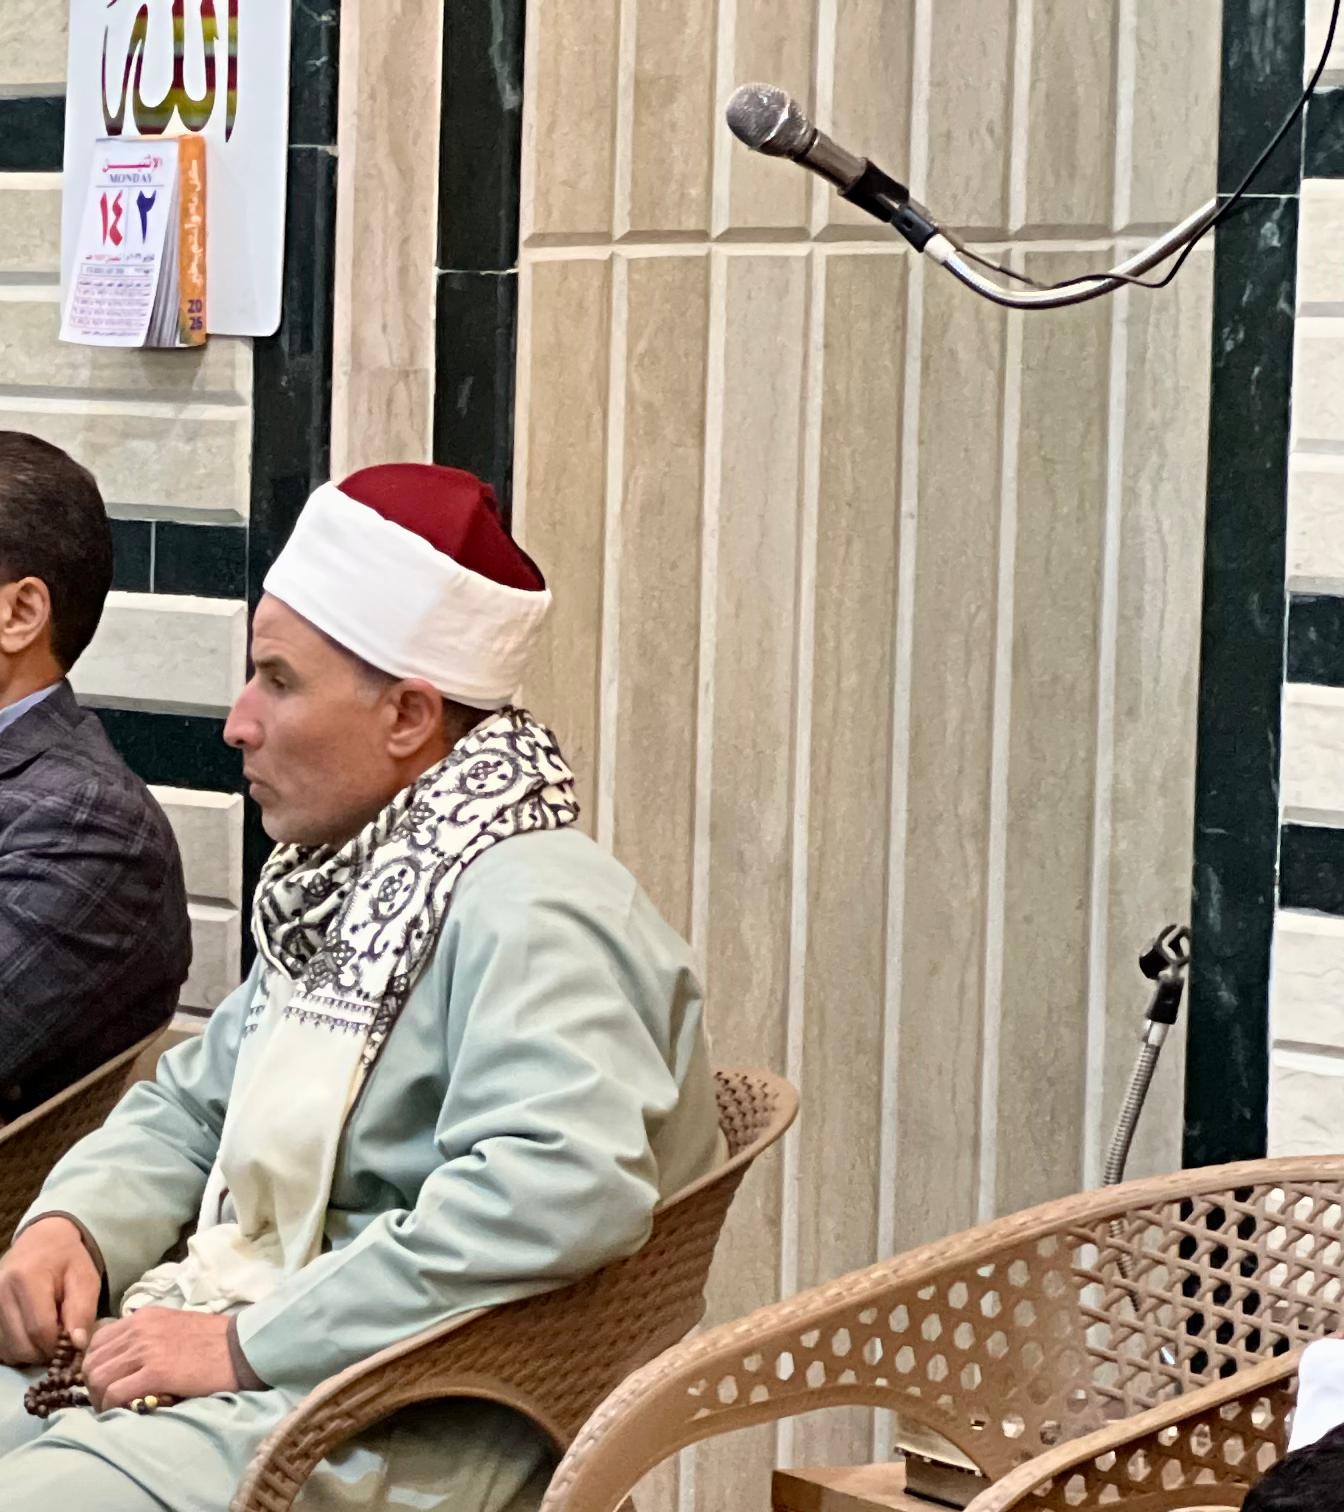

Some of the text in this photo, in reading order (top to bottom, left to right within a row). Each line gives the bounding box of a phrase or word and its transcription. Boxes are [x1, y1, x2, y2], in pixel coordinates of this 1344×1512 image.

[109, 173, 153, 183] MONDAY
[100, 190, 123, 246] ١٤
[136, 190, 156, 244] ٢
[188, 299, 202, 313] 20
[190, 316, 203, 331] 26
